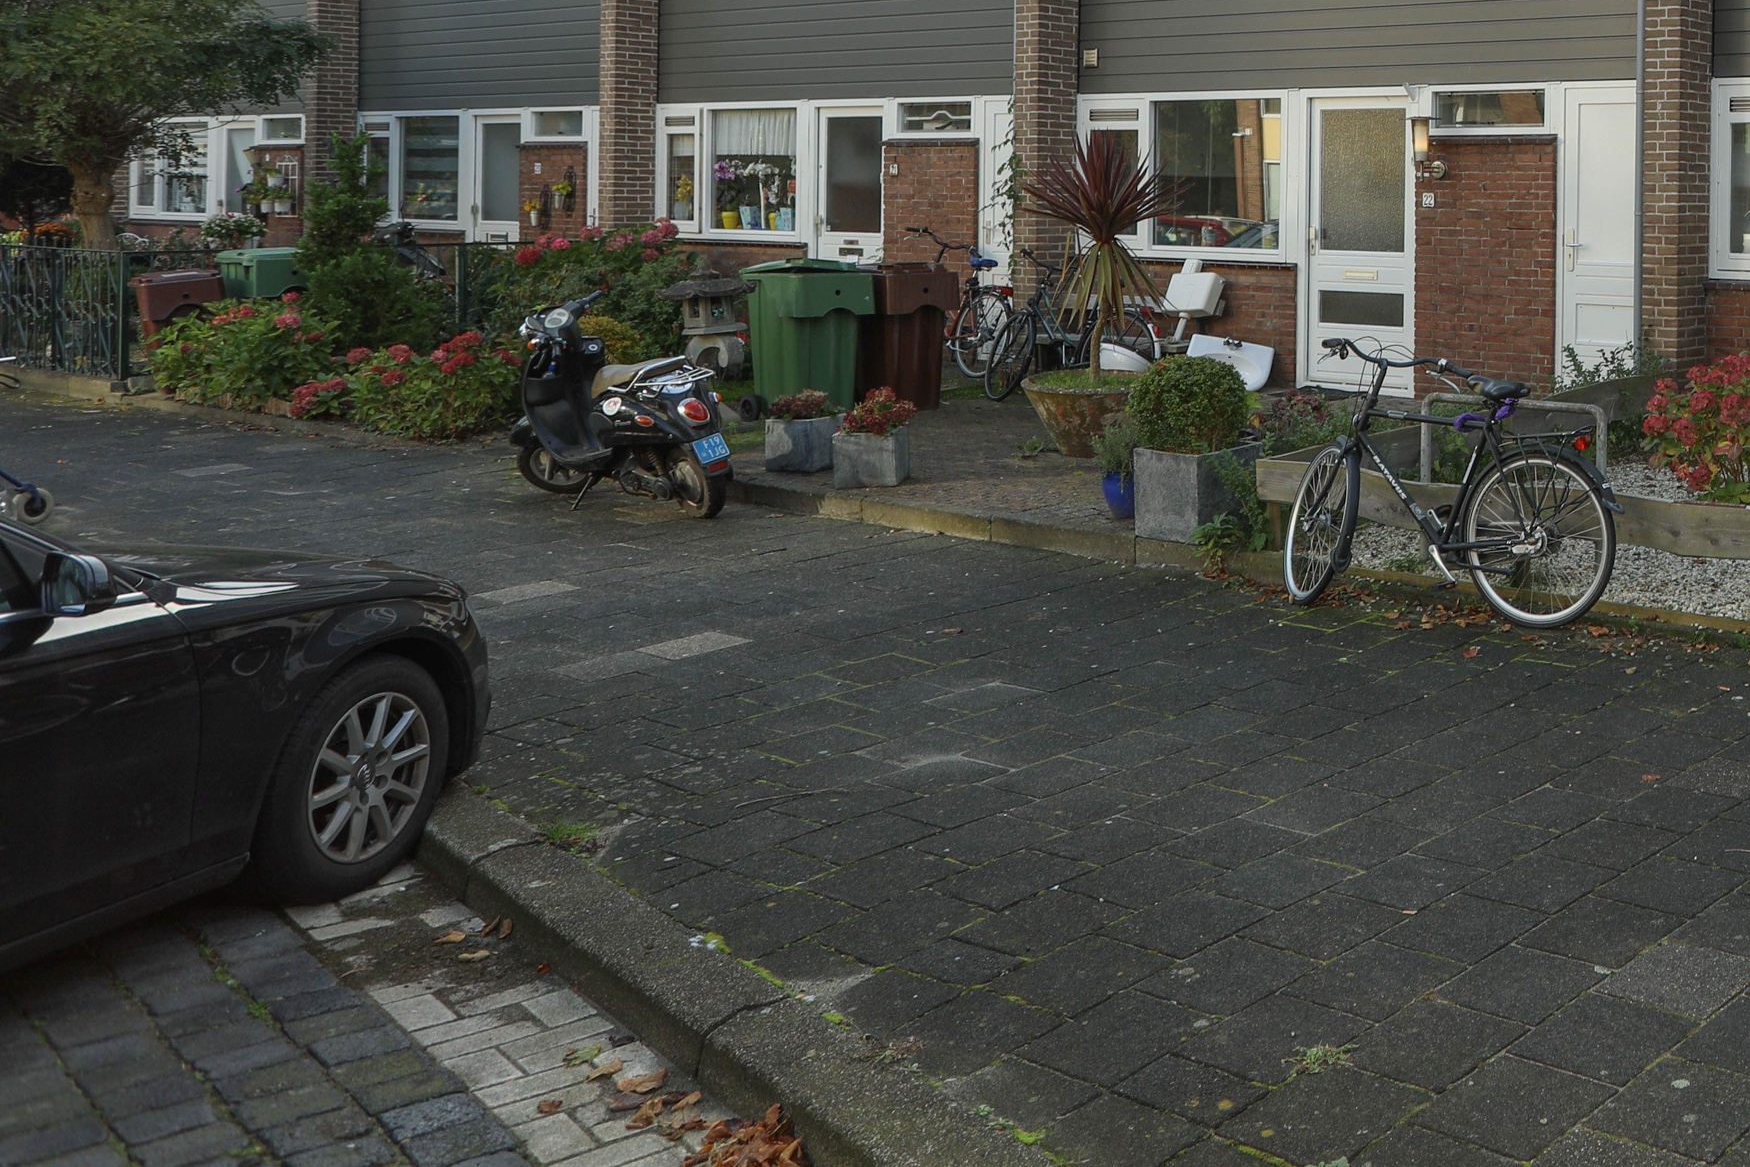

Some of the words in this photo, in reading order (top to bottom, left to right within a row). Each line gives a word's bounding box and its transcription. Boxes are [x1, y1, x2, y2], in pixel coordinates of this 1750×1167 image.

[1424, 194, 1433, 205] 22
[702, 436, 720, 449] F19
[708, 445, 726, 458] 1JG
[1373, 455, 1407, 500] BATAVUS
